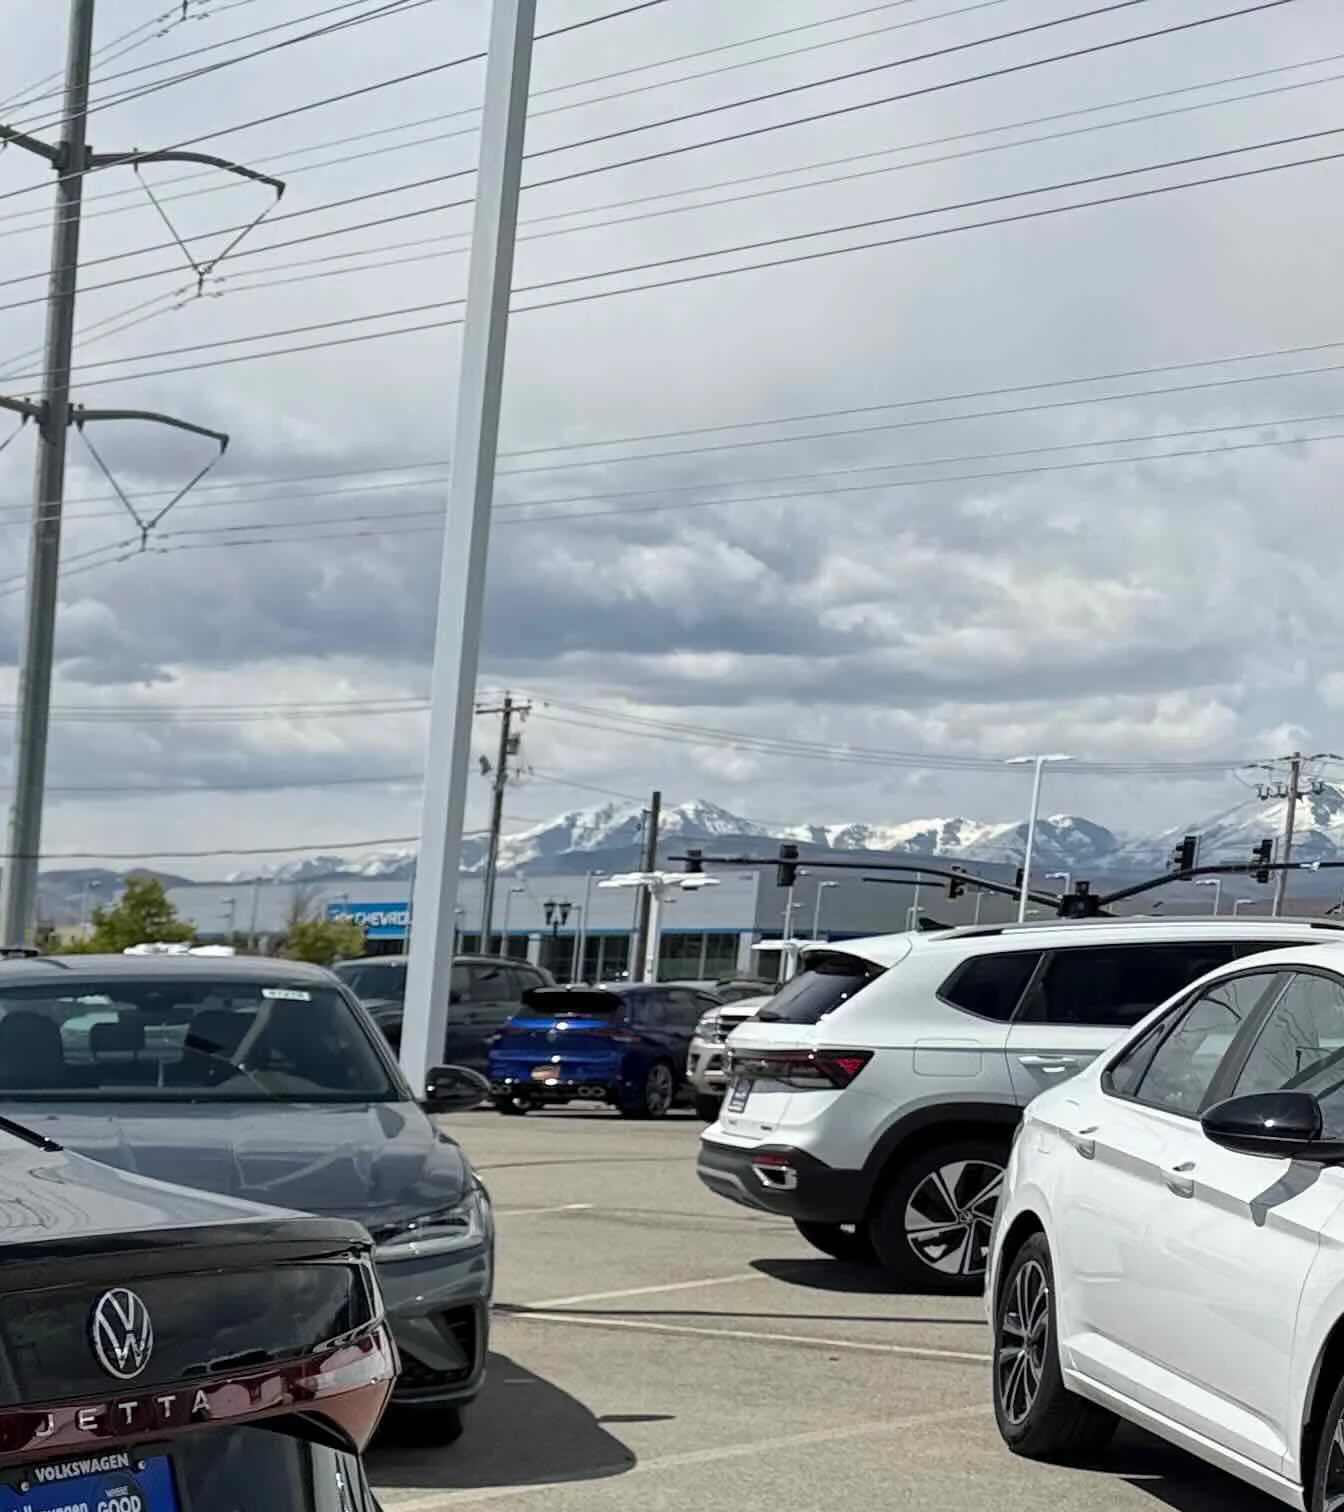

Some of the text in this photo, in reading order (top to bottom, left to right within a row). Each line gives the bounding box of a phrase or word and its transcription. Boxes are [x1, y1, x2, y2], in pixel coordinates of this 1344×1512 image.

[354, 910, 411, 928] CHEVRO
[35, 1389, 210, 1437] JETTA
[34, 1452, 130, 1483] VOLKSWAGEN
